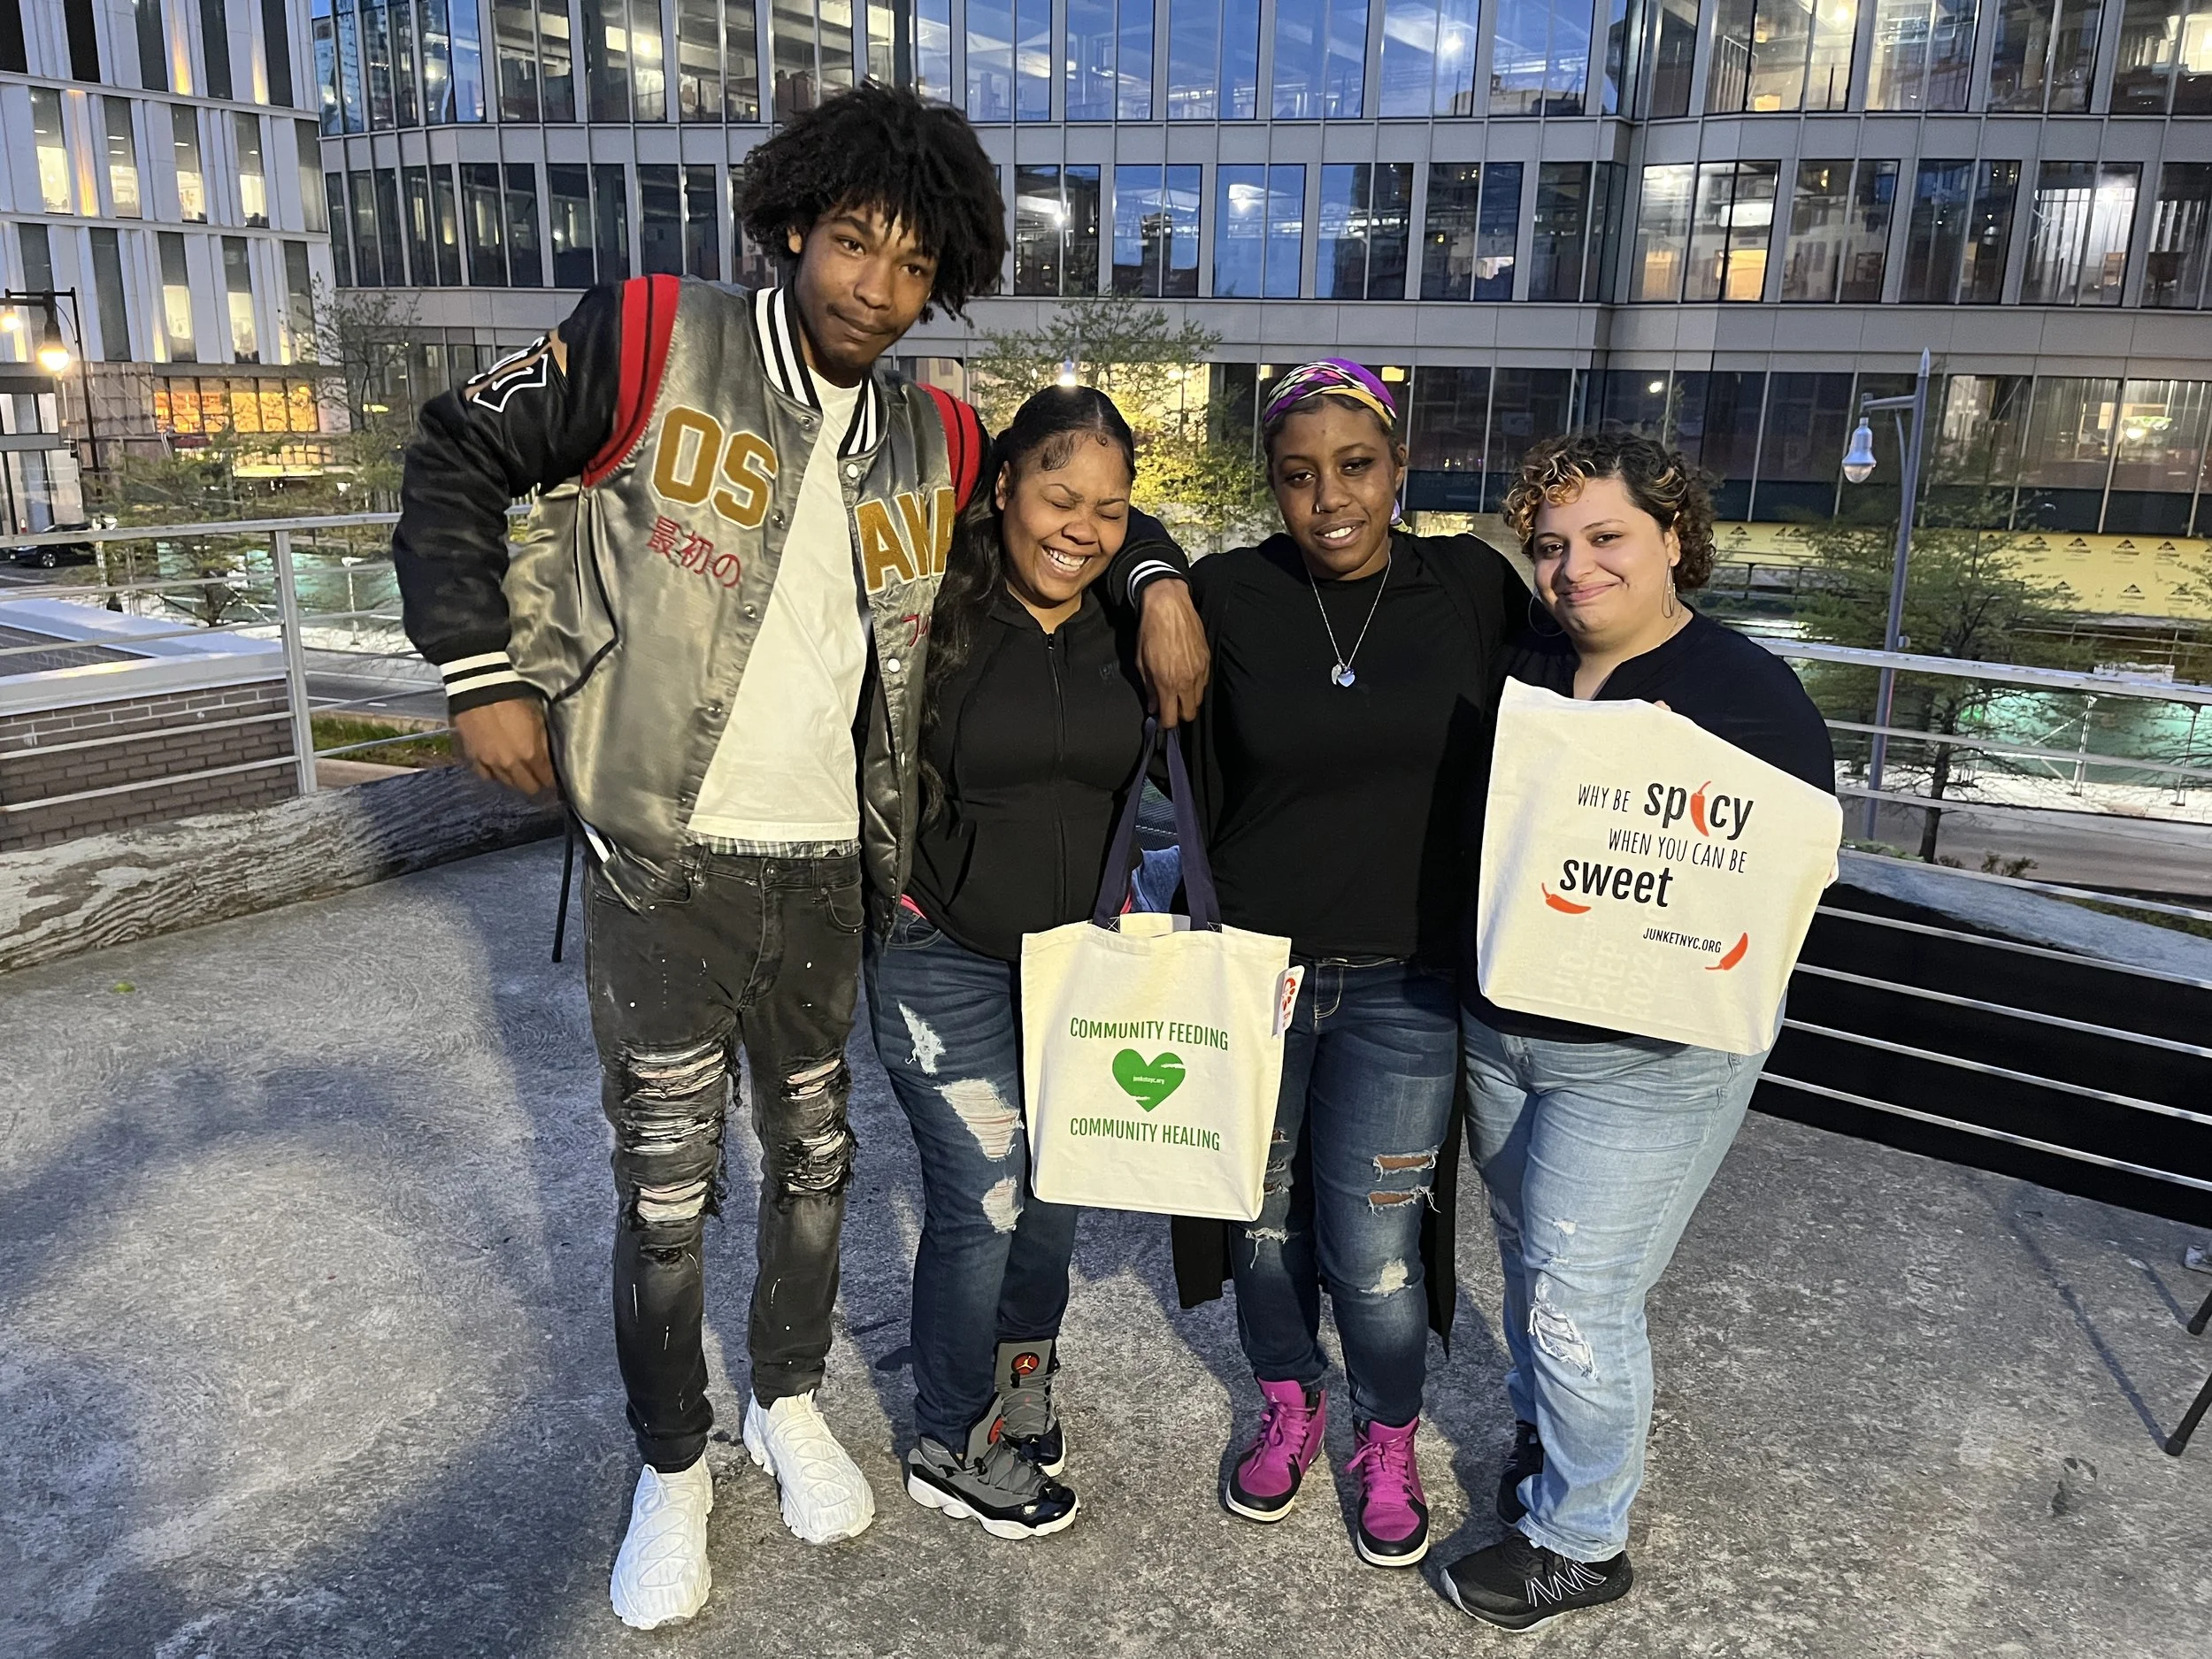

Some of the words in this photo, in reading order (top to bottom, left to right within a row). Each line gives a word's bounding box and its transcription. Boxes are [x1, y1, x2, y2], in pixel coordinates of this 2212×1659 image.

[650, 403, 780, 532] OS
[644, 513, 743, 589] 最初の
[1578, 784, 1609, 808] WHY
[1612, 789, 1631, 812] BE
[1643, 780, 1755, 840] spicy
[1609, 828, 1651, 856] WHEN
[1658, 835, 1686, 863] YOU
[1692, 842, 1725, 869] CAN
[1729, 849, 1747, 873] BE
[1559, 859, 1673, 908] sweet
[1642, 927, 1722, 954] JUNKETNYC.ORG
[1071, 1017, 1164, 1040] COMMUNITY
[1168, 1021, 1229, 1051] FEEDING
[1070, 1118, 1158, 1143] COMMUNITY
[1162, 1124, 1221, 1152] HEALING
